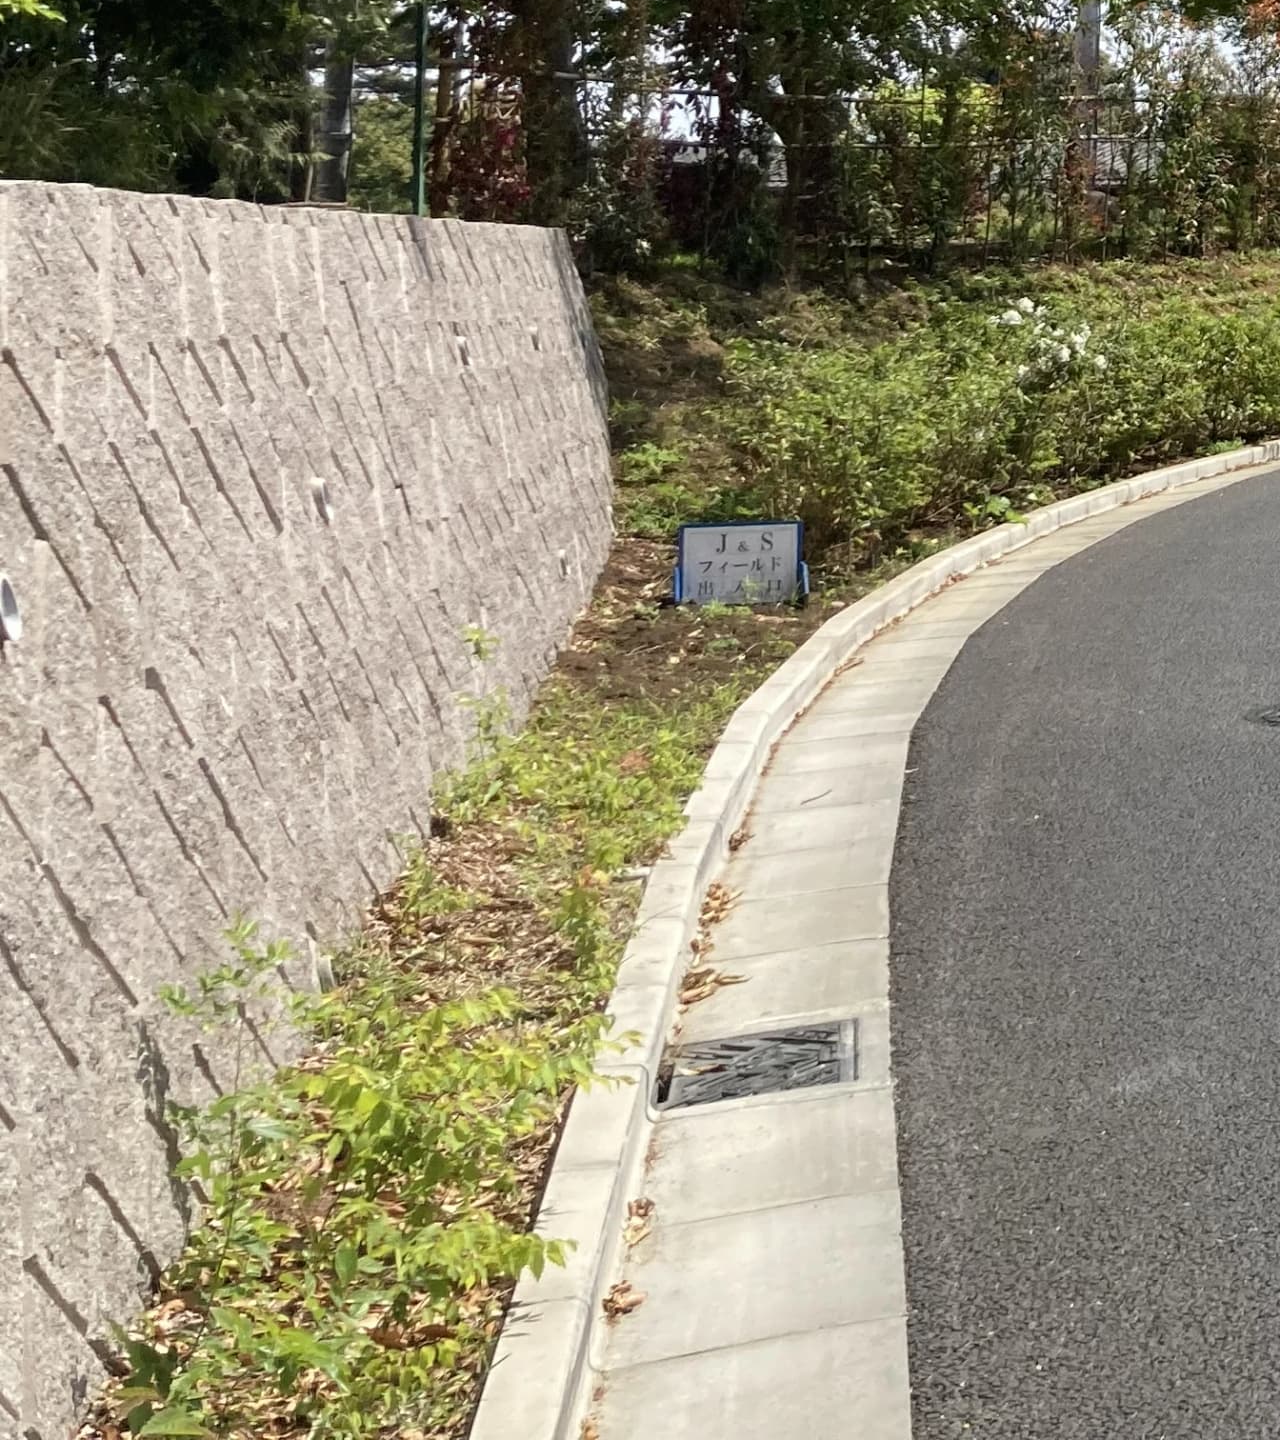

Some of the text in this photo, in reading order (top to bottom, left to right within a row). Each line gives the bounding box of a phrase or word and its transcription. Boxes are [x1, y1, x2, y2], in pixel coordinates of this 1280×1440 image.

[698, 556, 782, 574] フィールド
